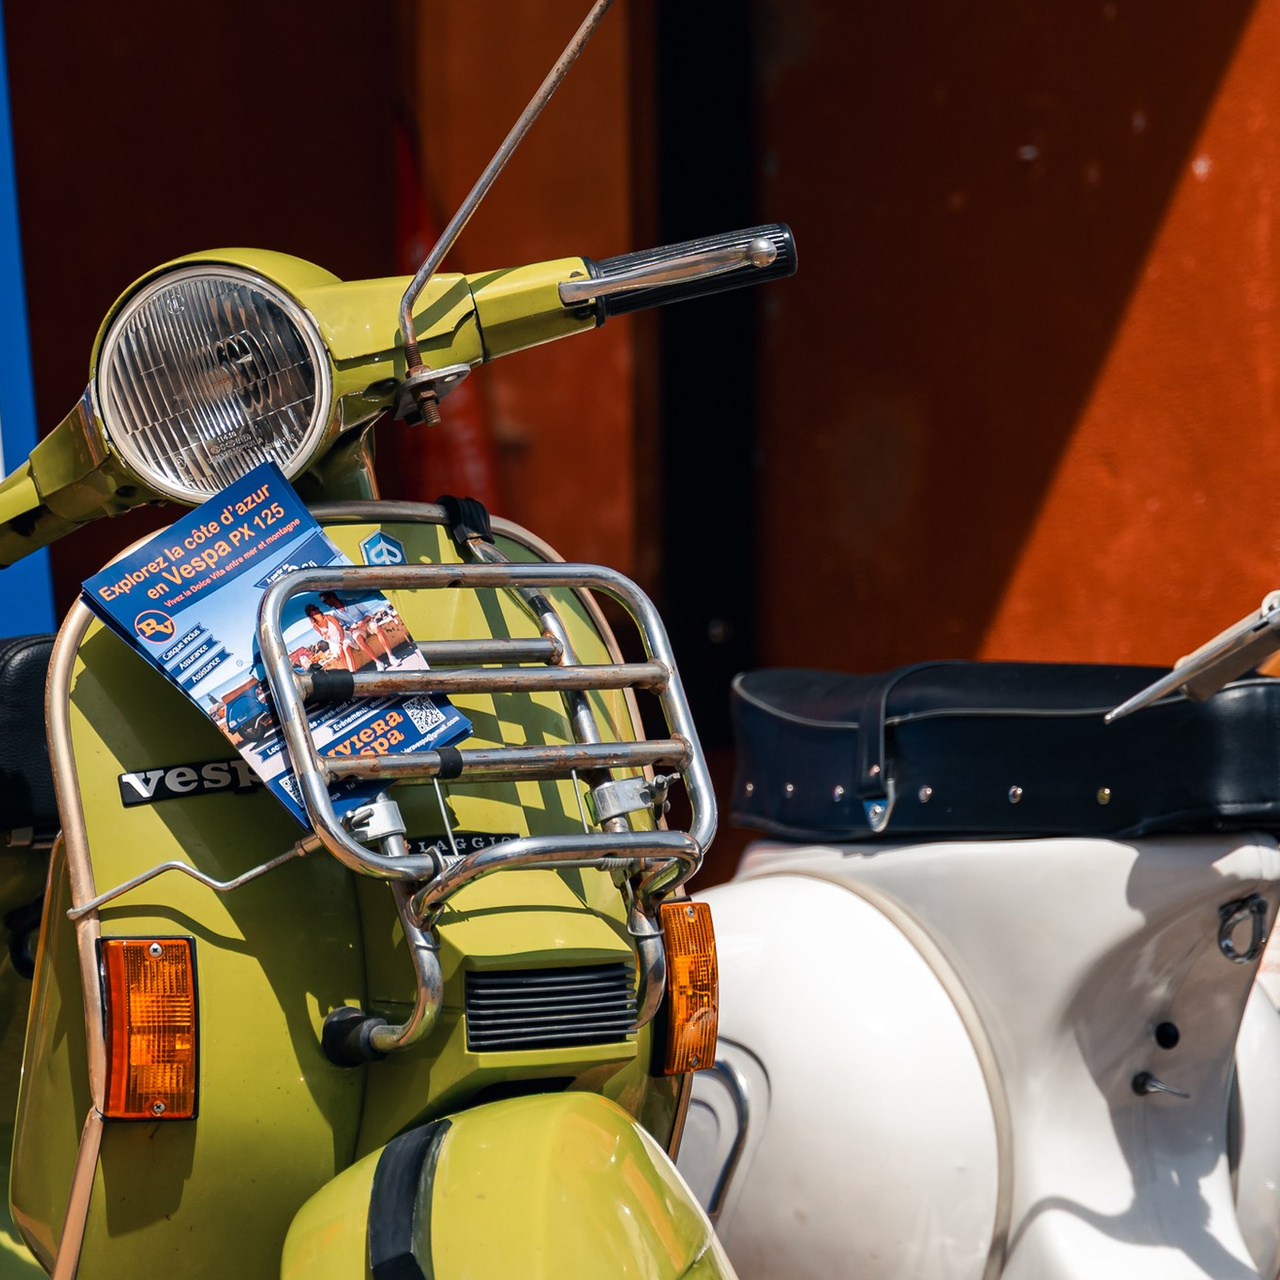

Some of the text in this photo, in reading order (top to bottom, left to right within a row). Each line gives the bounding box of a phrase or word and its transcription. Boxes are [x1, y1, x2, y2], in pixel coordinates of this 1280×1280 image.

[98, 558, 169, 602] Explorez
[163, 547, 185, 562] la
[183, 524, 221, 550] côte
[146, 502, 286, 600] en Vespa PX 125
[163, 593, 186, 609] Vivez
[190, 577, 213, 594] Dolce
[209, 568, 227, 581] Vita
[224, 558, 245, 573] entre
[243, 548, 258, 563] mer
[264, 518, 301, 546] montagne
[162, 628, 201, 661] Casque inclus
[179, 644, 209, 671] Assurance
[191, 657, 221, 684] Assistance
[407, 836, 513, 853] IAGGI
